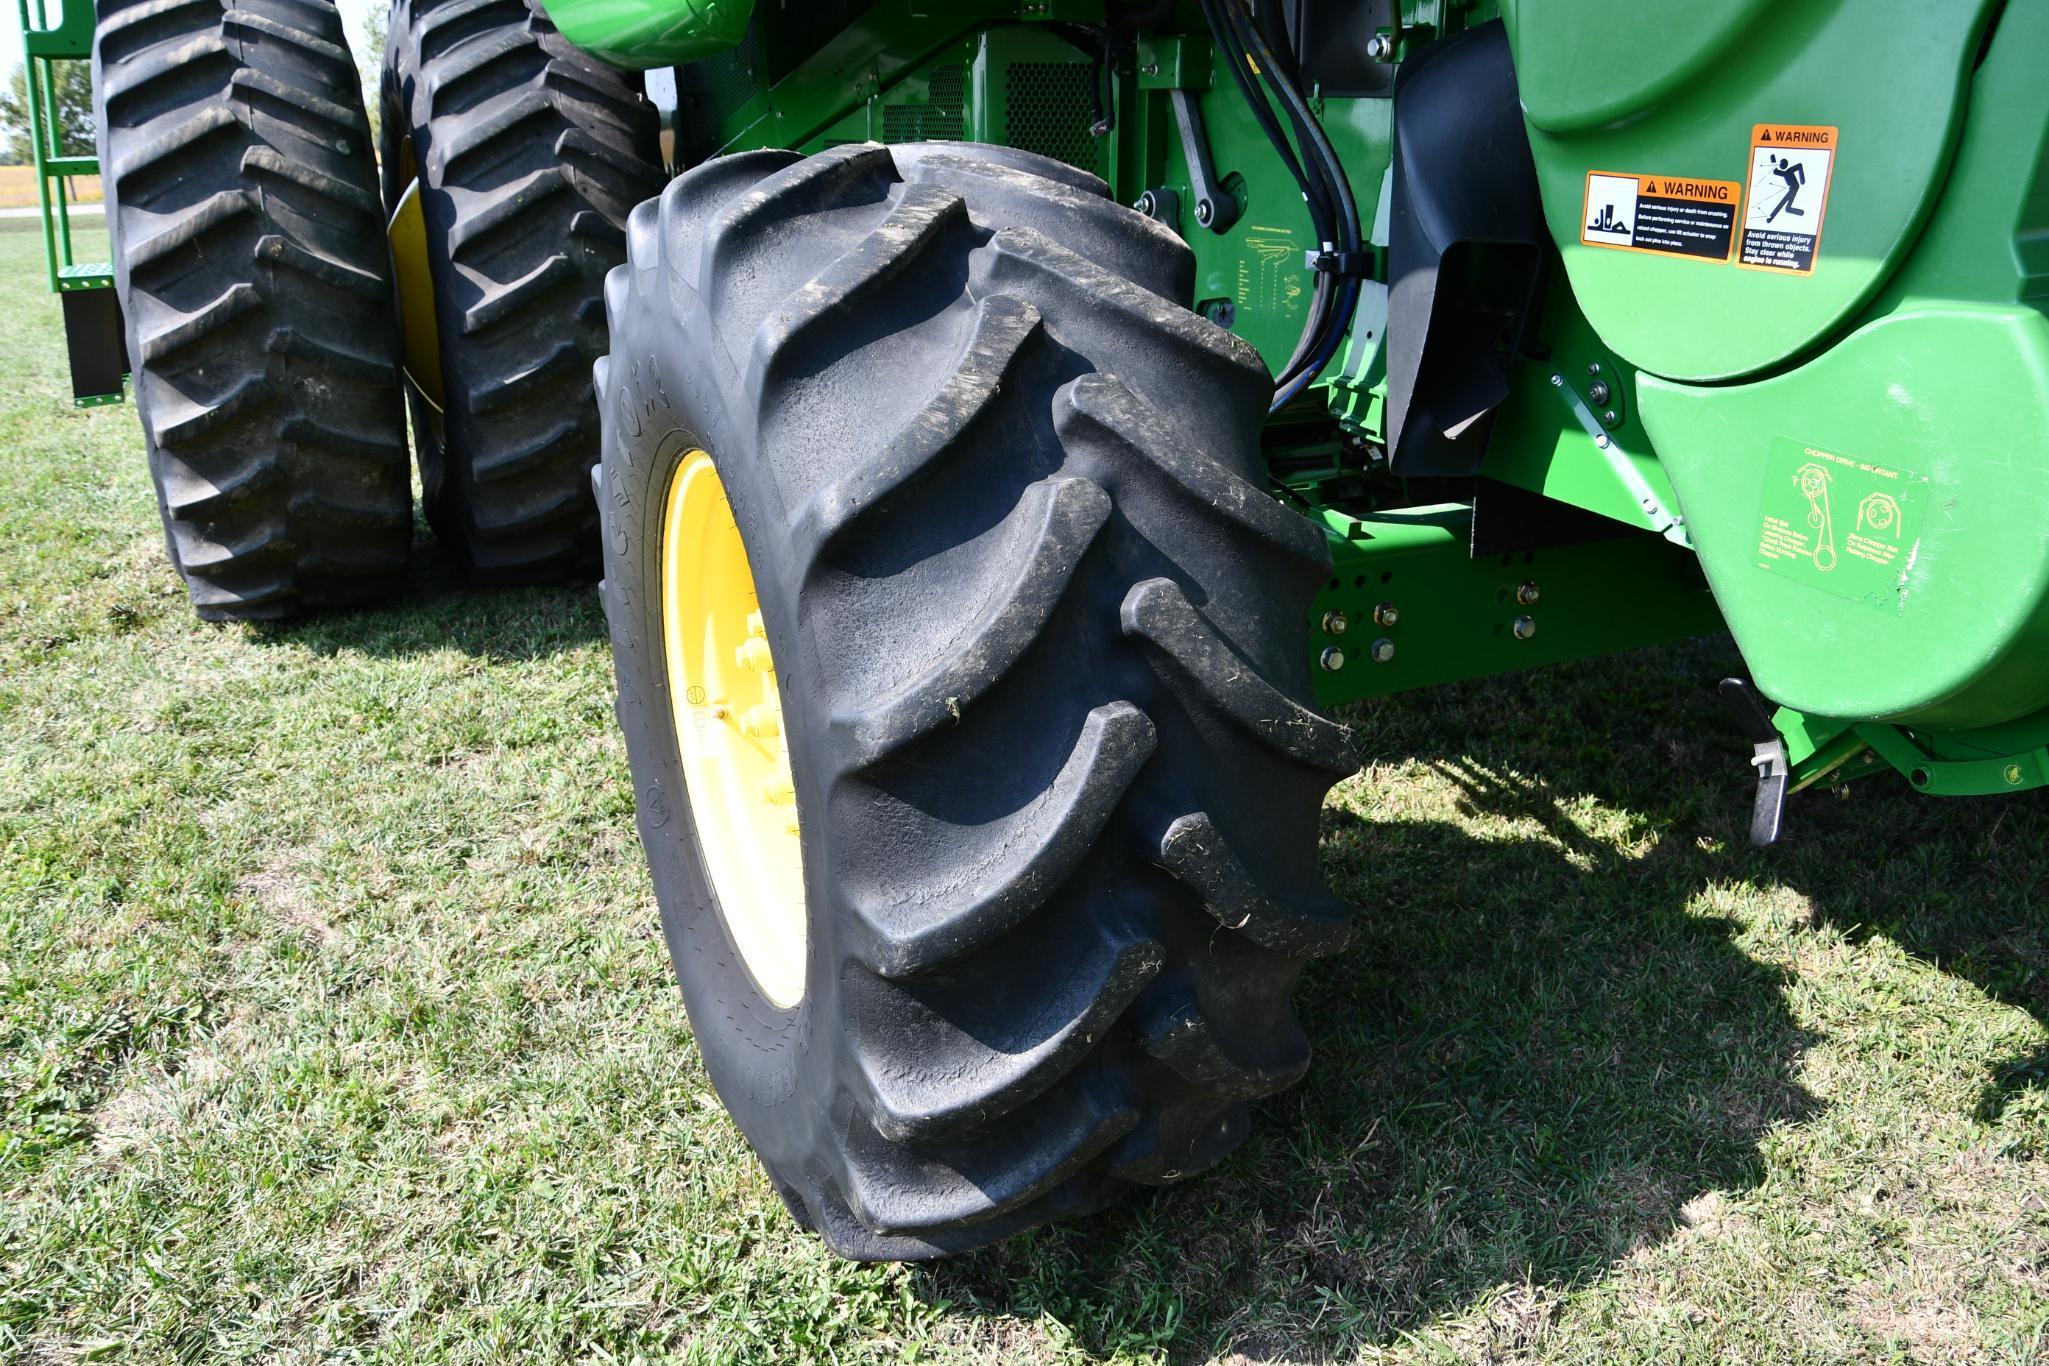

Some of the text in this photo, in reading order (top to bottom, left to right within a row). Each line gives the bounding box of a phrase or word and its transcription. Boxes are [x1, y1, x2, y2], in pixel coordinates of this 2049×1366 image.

[1775, 131, 1829, 143] WARNING
[1664, 181, 1728, 200] WARNING
[1652, 216, 1674, 224] performing
[1708, 210, 1728, 218] crushing.
[1747, 231, 1811, 245] Avoid serious injury
[1762, 241, 1784, 249] thrown
[1785, 244, 1811, 252] objects.
[1745, 247, 1759, 256] Stay
[1777, 251, 1794, 259] while
[1743, 256, 1765, 264] engine
[1773, 258, 1800, 268] running.
[1804, 447, 1835, 462] CHOPPER
[1836, 456, 1856, 468] DRIVE
[1860, 463, 1899, 480] IMPORTANT
